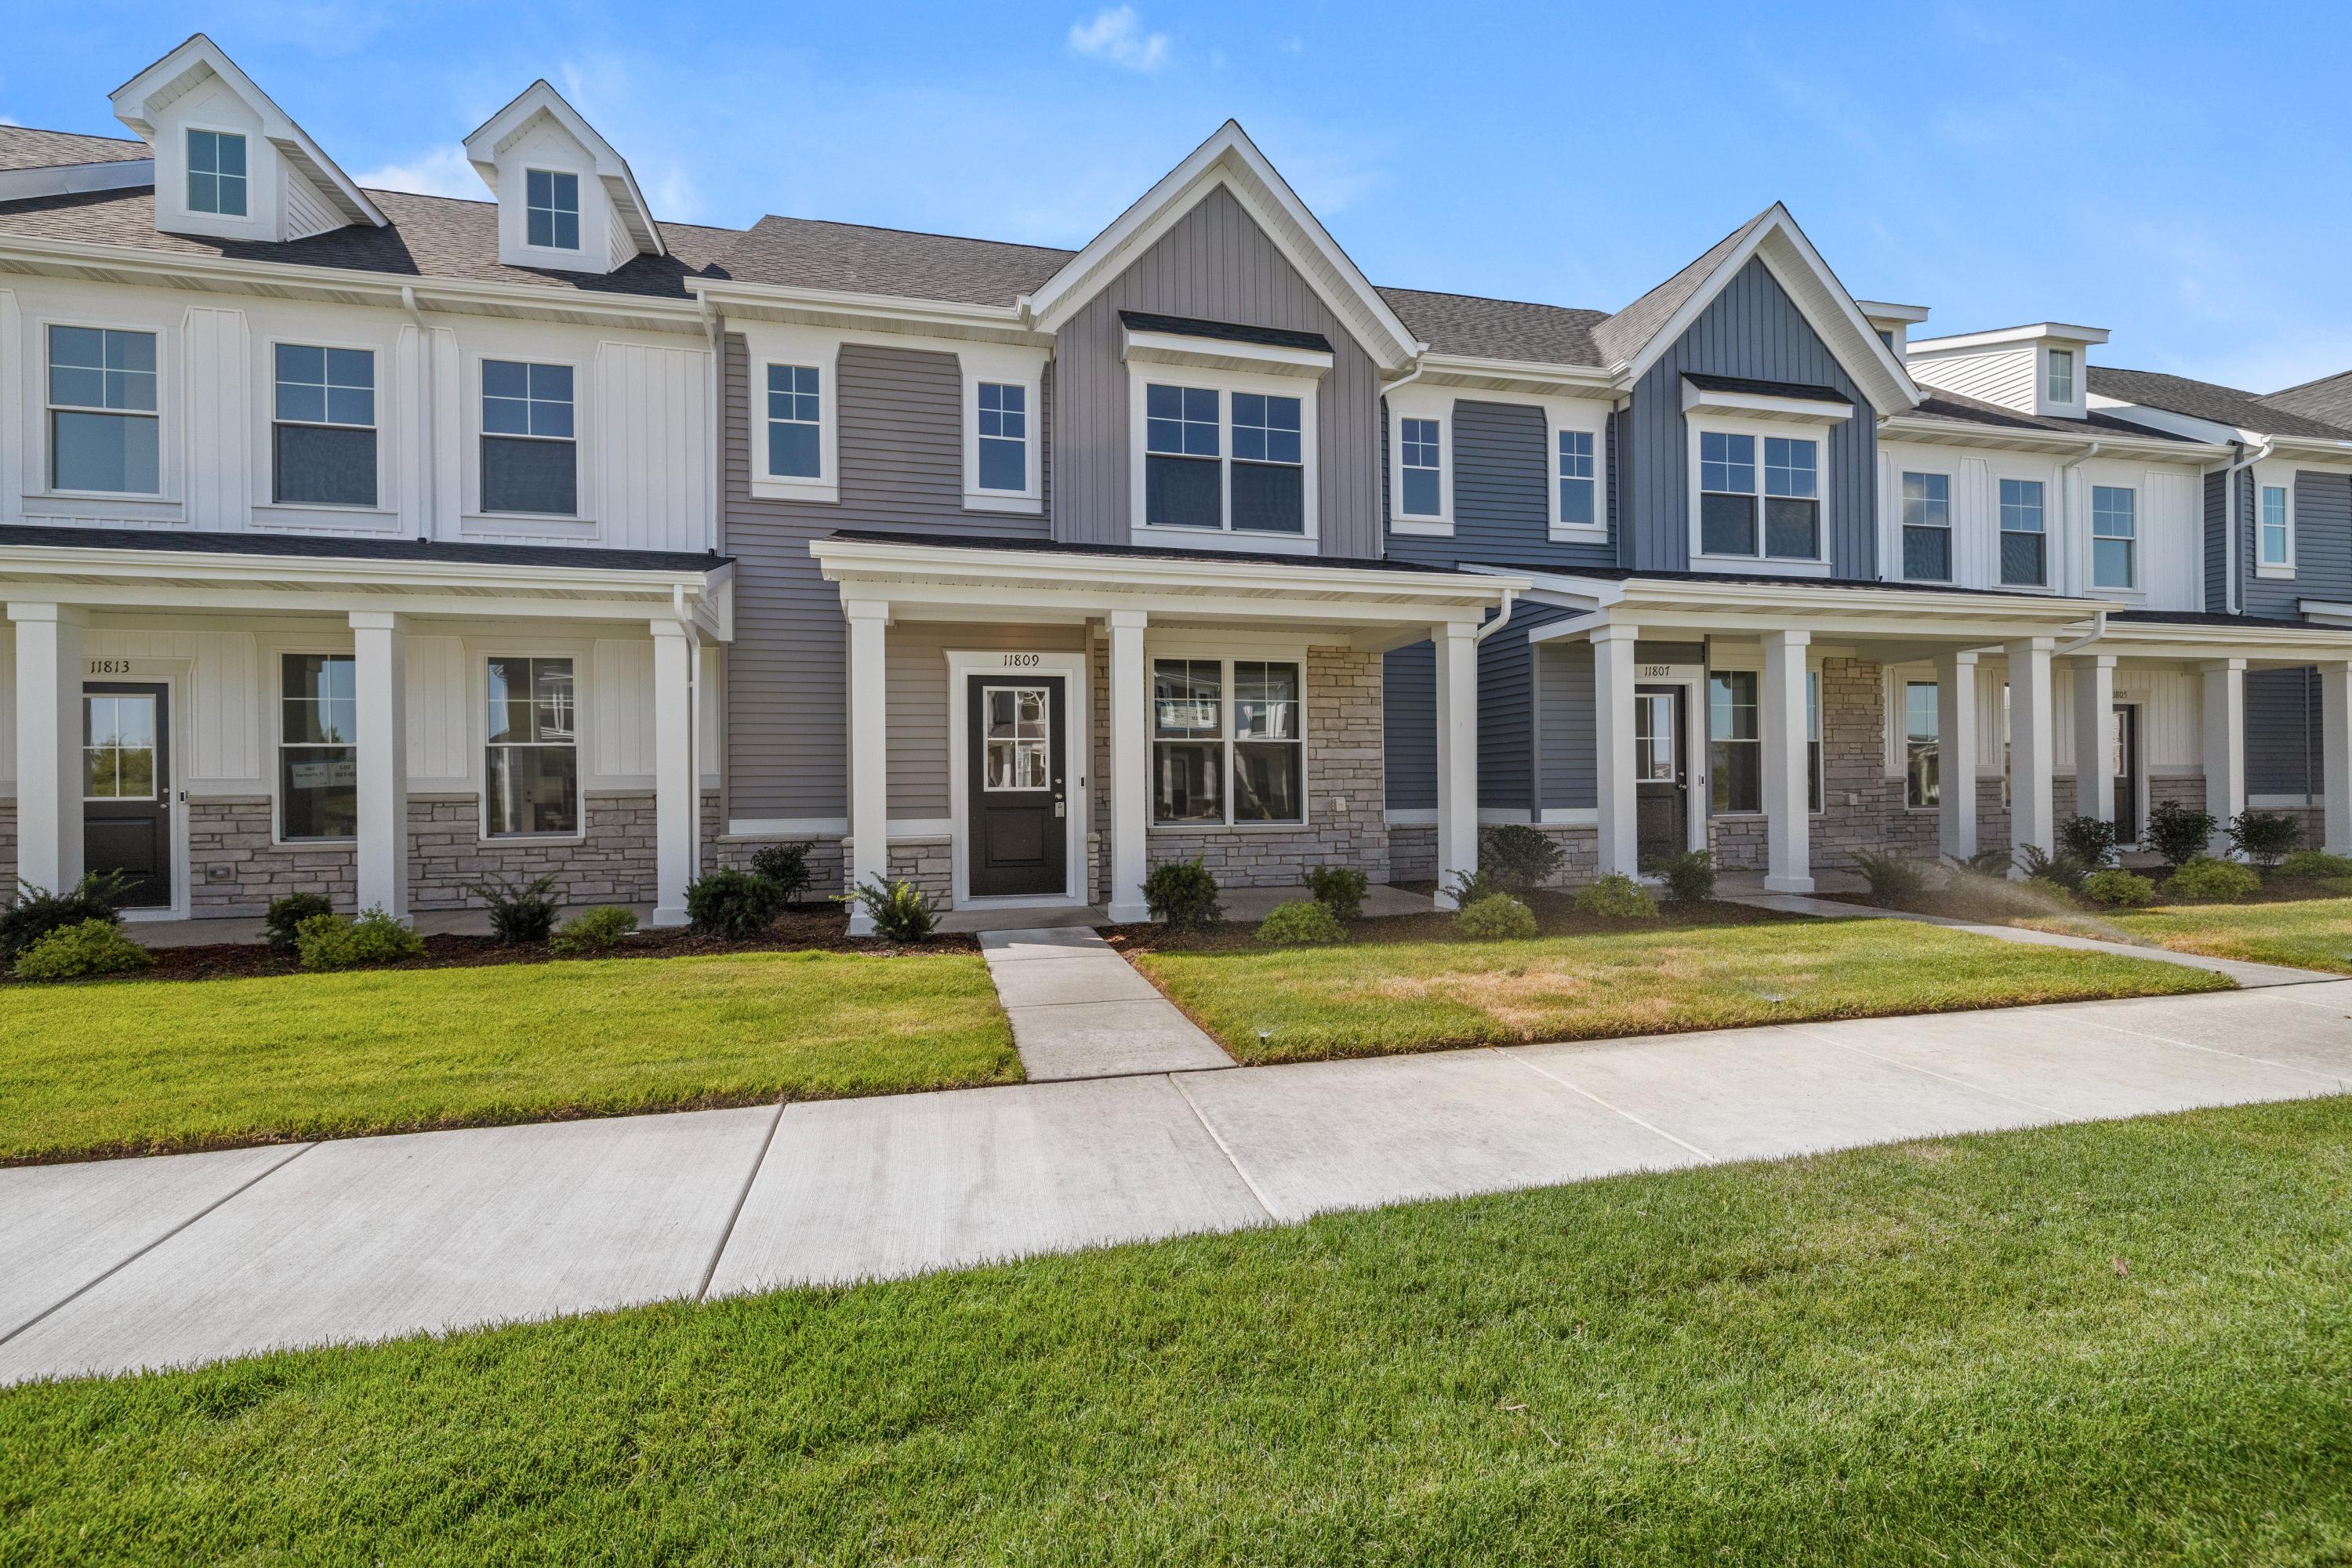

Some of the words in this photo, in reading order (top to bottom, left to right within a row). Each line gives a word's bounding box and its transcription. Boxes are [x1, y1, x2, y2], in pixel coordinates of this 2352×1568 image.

[1004, 654, 1040, 666] 11809
[91, 660, 129, 673] 11813
[1644, 666, 1670, 677] 11807
